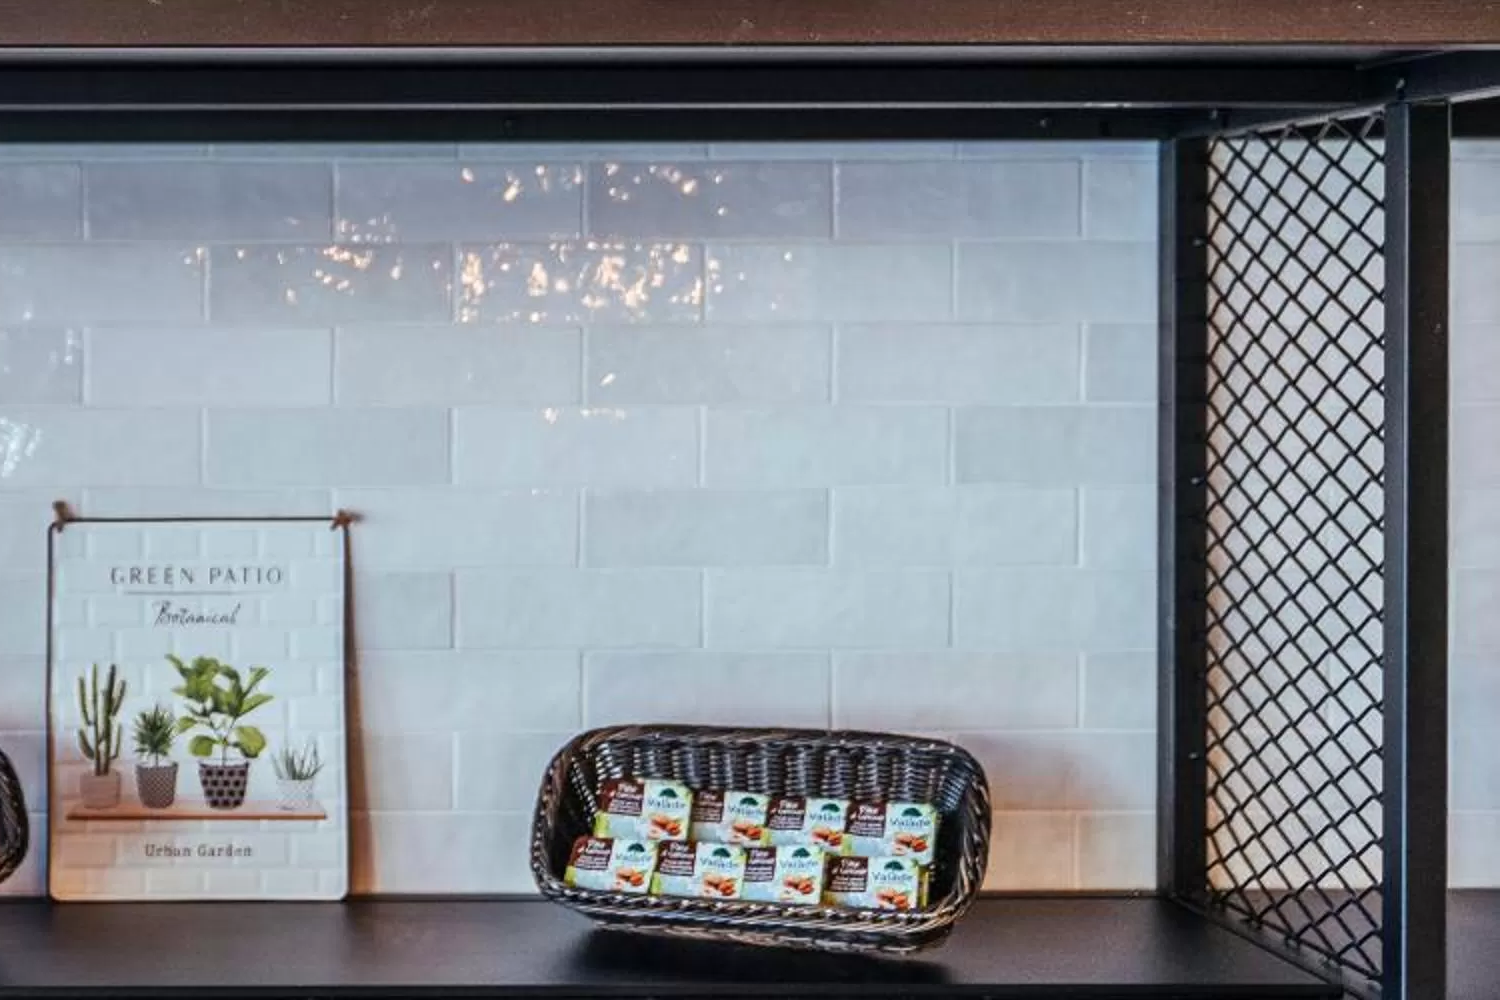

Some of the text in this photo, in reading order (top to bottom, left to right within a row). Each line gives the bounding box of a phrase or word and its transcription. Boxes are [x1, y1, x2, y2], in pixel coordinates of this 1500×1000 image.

[109, 566, 283, 585] GREEN PATIO
[151, 600, 242, 628] Botanical
[145, 843, 252, 857] Urban Garden
